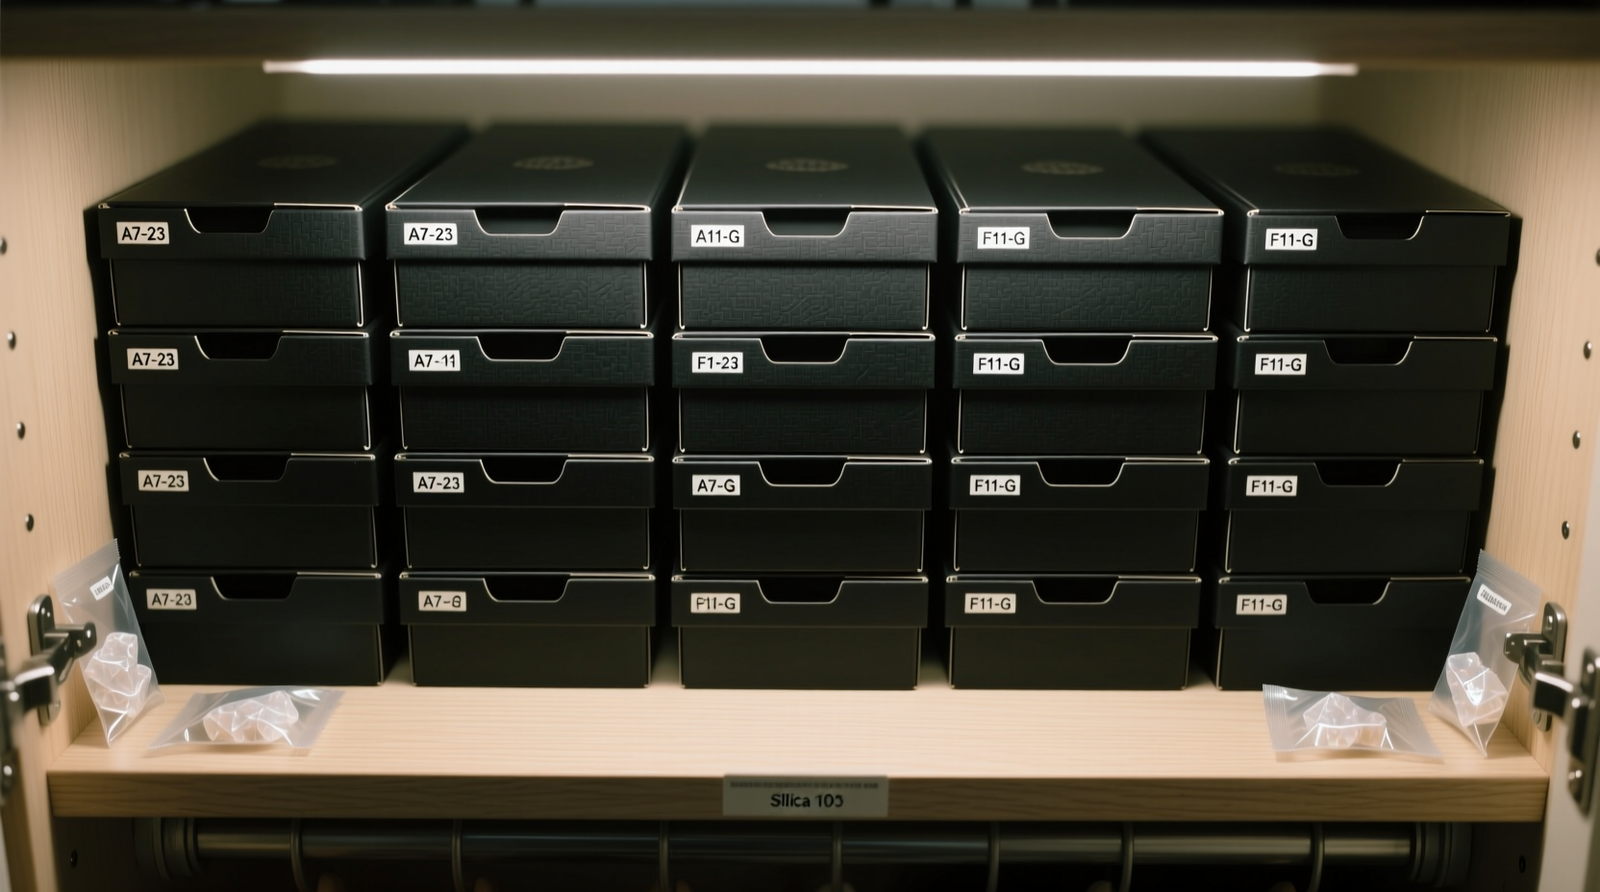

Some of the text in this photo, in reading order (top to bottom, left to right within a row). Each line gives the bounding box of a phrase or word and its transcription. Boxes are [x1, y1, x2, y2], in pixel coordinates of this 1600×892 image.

[121, 226, 166, 241] A7-23
[408, 227, 453, 241] A7-23
[695, 229, 740, 244] A11-G
[983, 231, 1025, 246] F11-G
[1270, 232, 1314, 247] F11-G
[131, 352, 175, 367] A7-23
[697, 356, 739, 370] F1-23
[978, 357, 1020, 371] F11-G
[1260, 357, 1302, 372] F11-G
[142, 474, 185, 488] A7-23
[417, 476, 460, 490] A7-23
[697, 478, 736, 493] A7-G
[974, 478, 1016, 493] F11-G
[1251, 479, 1293, 493] F11-G
[151, 593, 192, 606] A7-23
[970, 597, 1011, 611] F11-G
[1241, 598, 1283, 611] F11-G
